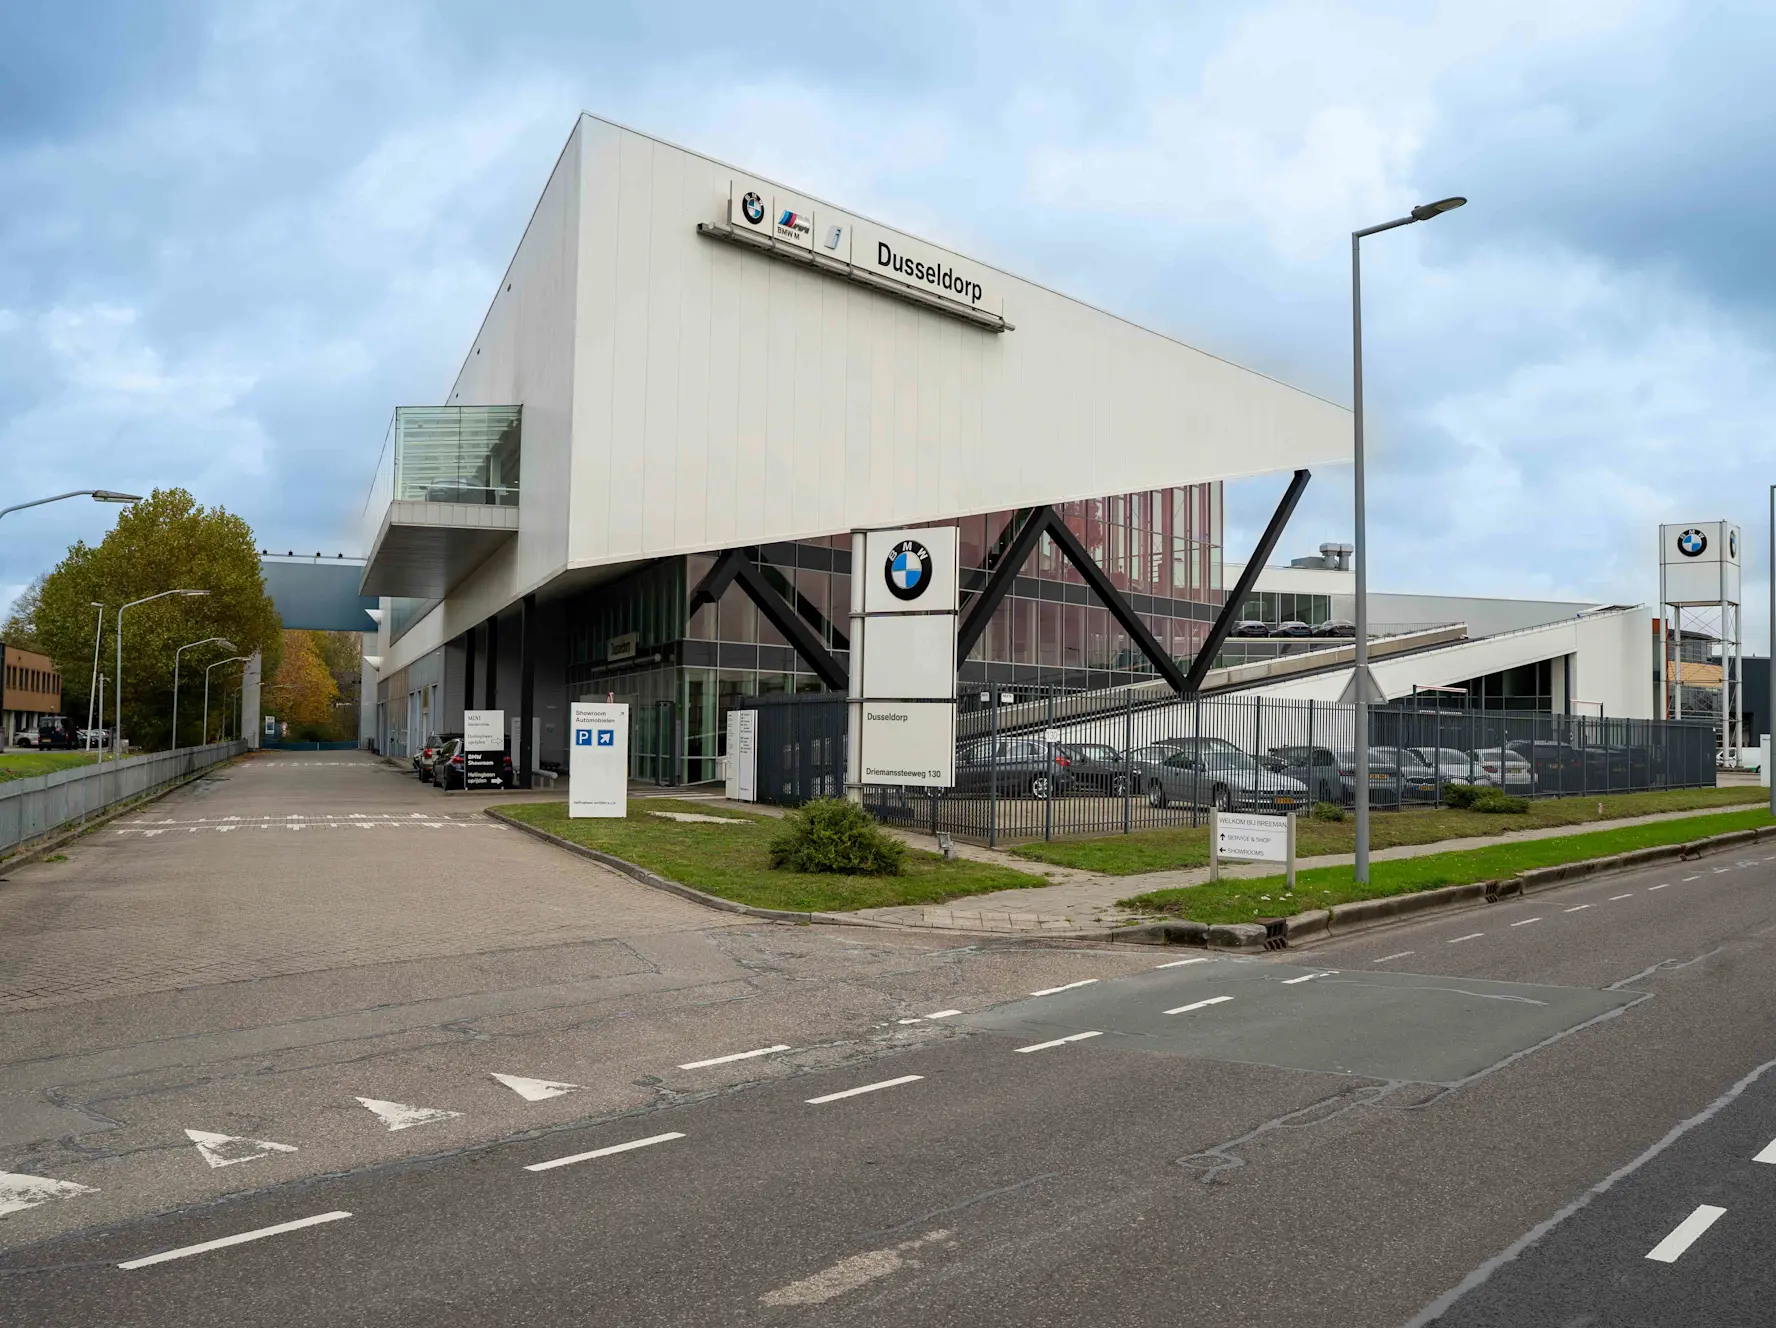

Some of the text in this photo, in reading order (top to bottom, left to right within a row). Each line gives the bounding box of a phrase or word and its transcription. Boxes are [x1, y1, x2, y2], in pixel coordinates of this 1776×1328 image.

[777, 226, 800, 240] BMW M
[878, 241, 982, 303] Dusseldorp
[867, 712, 908, 722] Dusseldorp
[579, 731, 589, 744] P
[1046, 730, 1058, 740] 130
[866, 767, 941, 779] Driemanssteeweg 130
[1219, 817, 1246, 825] WELKOM
[1257, 820, 1287, 828] BREEMAN
[1227, 834, 1250, 842] SERVICE
[1227, 847, 1264, 856] SHOWROOMS
